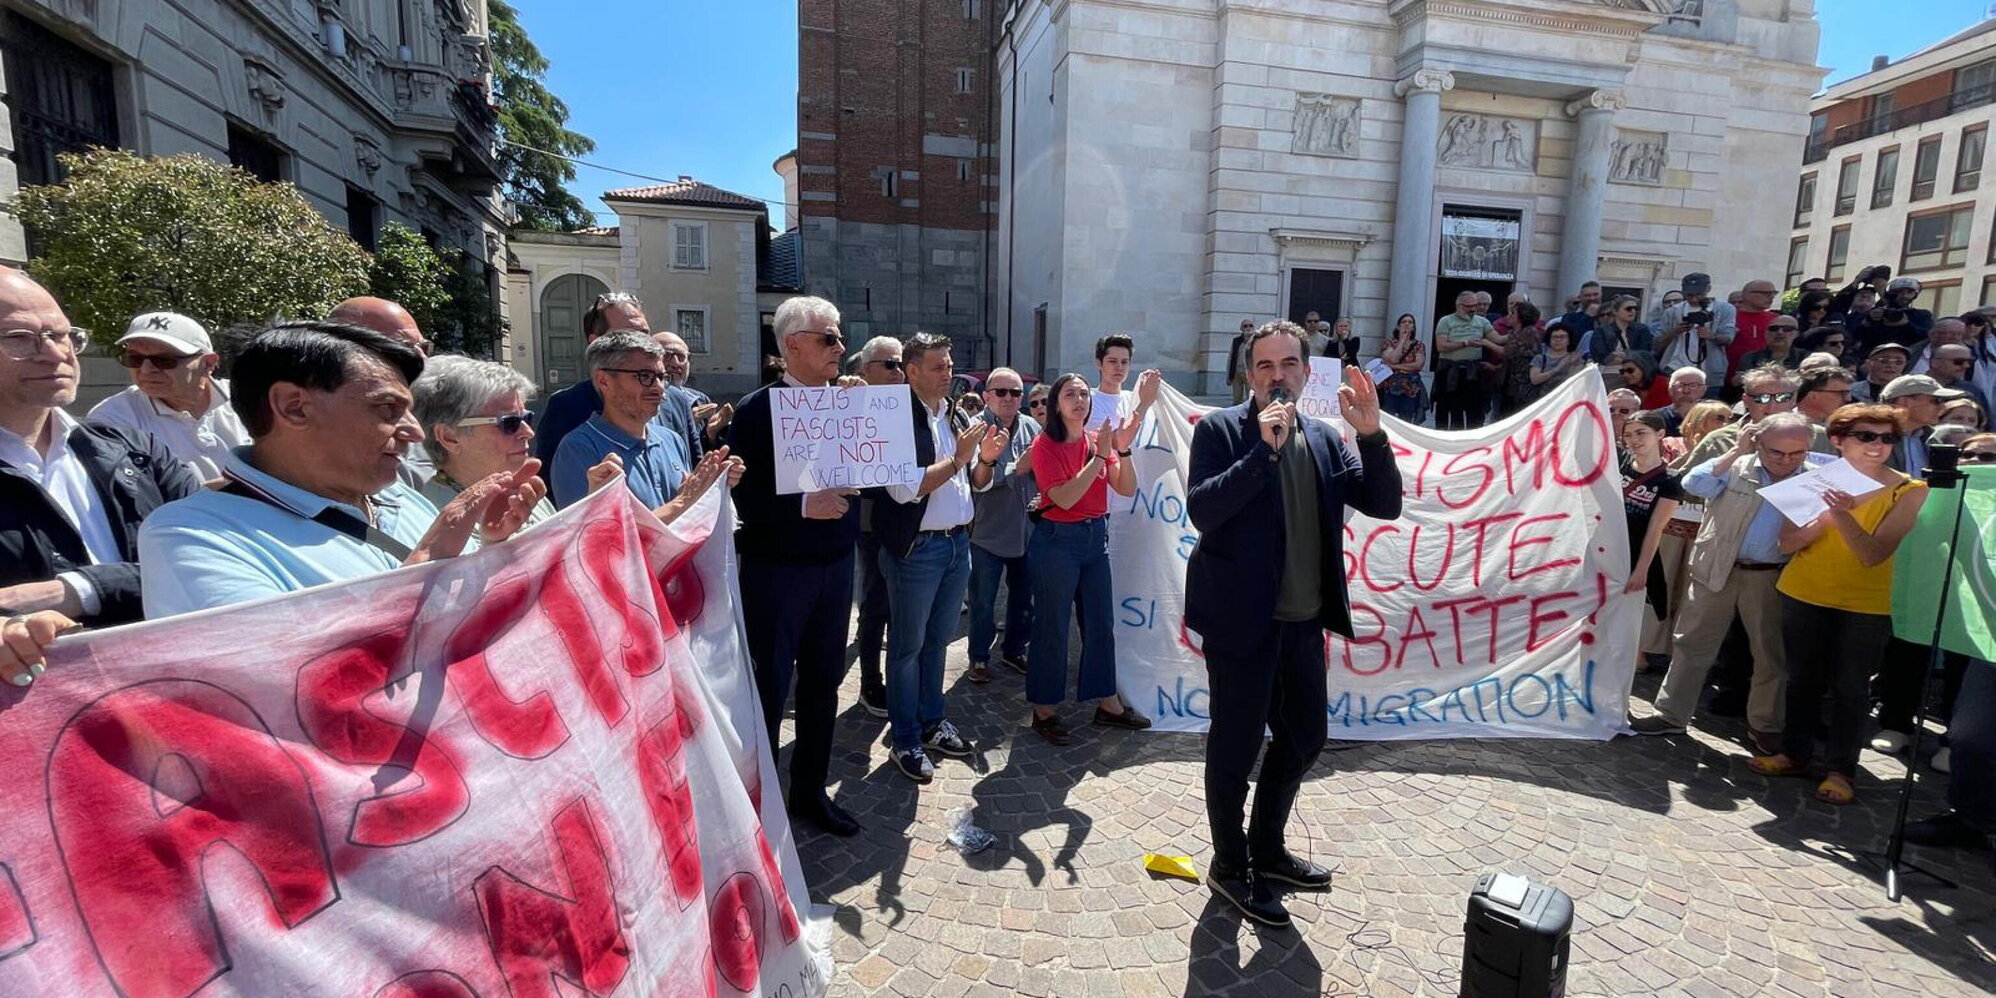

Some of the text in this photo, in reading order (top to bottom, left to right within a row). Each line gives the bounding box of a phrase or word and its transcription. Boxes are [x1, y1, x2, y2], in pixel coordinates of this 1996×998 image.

[779, 389, 899, 411] NAZIS AND
[781, 417, 877, 440] FASCISTS
[783, 441, 889, 464] ARE NOT
[810, 462, 918, 489] WELCOME
[1130, 482, 1188, 528] NO
[1121, 597, 1155, 629] SI
